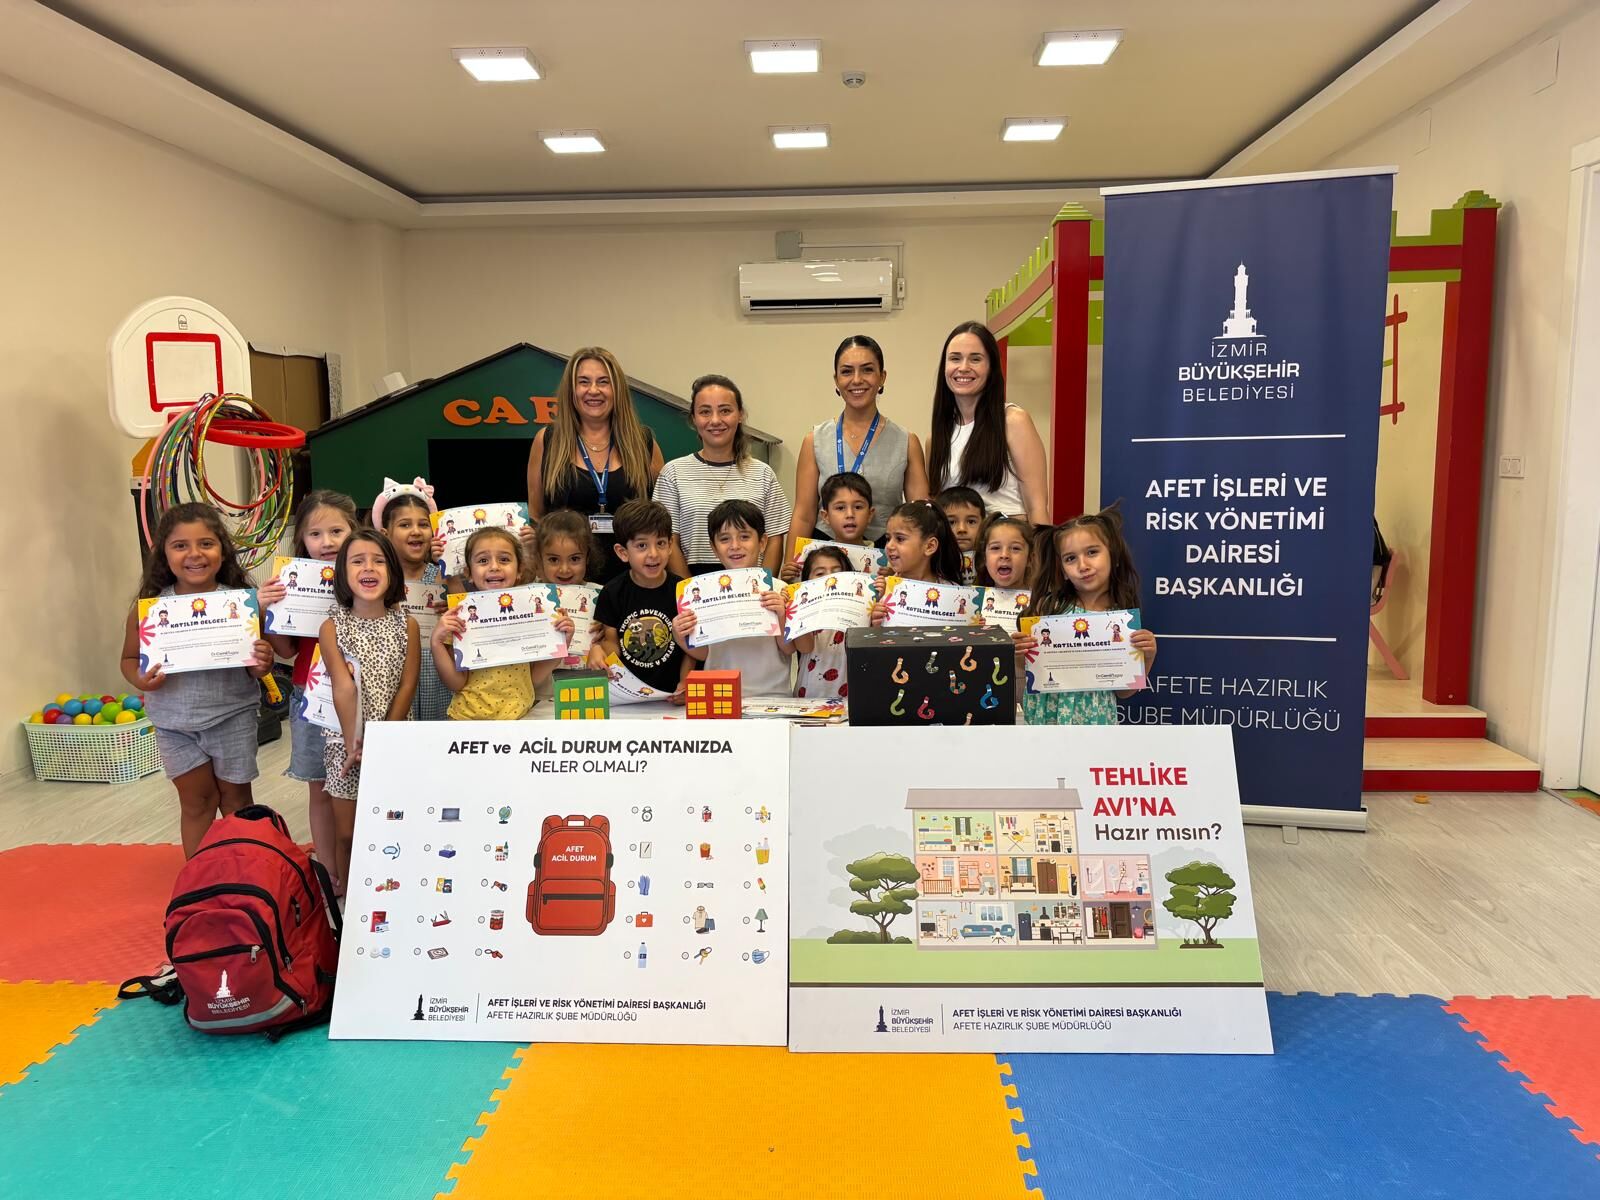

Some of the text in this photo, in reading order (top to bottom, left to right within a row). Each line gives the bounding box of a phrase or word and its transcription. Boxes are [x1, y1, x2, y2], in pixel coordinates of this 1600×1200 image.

[1211, 340, 1267, 358] İZMİR
[1178, 360, 1300, 381] BÜYÜKŞEHİR
[1183, 383, 1294, 402] BELEDİYESİ
[443, 396, 560, 426] CAF
[1145, 473, 1328, 501] AFET İŞLERİ VE
[1145, 507, 1325, 530] RİSK YÖNETİMİ
[1186, 539, 1280, 564] DAİRESİ
[1155, 573, 1303, 599] BAŞKANLIĞI
[620, 611, 639, 632] TROPIC
[662, 641, 676, 663] AFTER
[630, 657, 654, 668] SHORT
[1221, 678, 1328, 699] HAZIRLIK
[1181, 706, 1340, 732] MÜDÜRLÜĞÜ
[448, 737, 733, 757] AFET ve ACİL DURUM ÇANTANIZDA
[531, 760, 648, 773] NELER OLMALI?
[1089, 762, 1188, 786] TEHLİKE
[1095, 822, 1222, 840] Hazır mısın?
[551, 854, 568, 862] ACİL
[565, 845, 585, 853] AFET
[428, 1005, 469, 1013] BÜYÜKŞEHİR
[488, 997, 706, 1010] AFET İŞLERİ VE RİSK YÖNETİMİ DAİRESİ BAŞKANLIĞI
[952, 1006, 1182, 1019] AFET İŞLERİ VE RİSK YÖNETİMİ DAİRESİ BAŞKANLIĞI
[486, 1011, 637, 1021] AFETE HAZIRLIK ŞUBE MÜDÜRLÜĞÜ
[891, 1016, 934, 1025] BÜYÜKŞEHİR
[891, 1025, 931, 1033] BELEDİYESİ
[953, 1020, 1112, 1031] AFETE HAZIRLIK ŞUBE MÜDÜRLÜĞÜ
